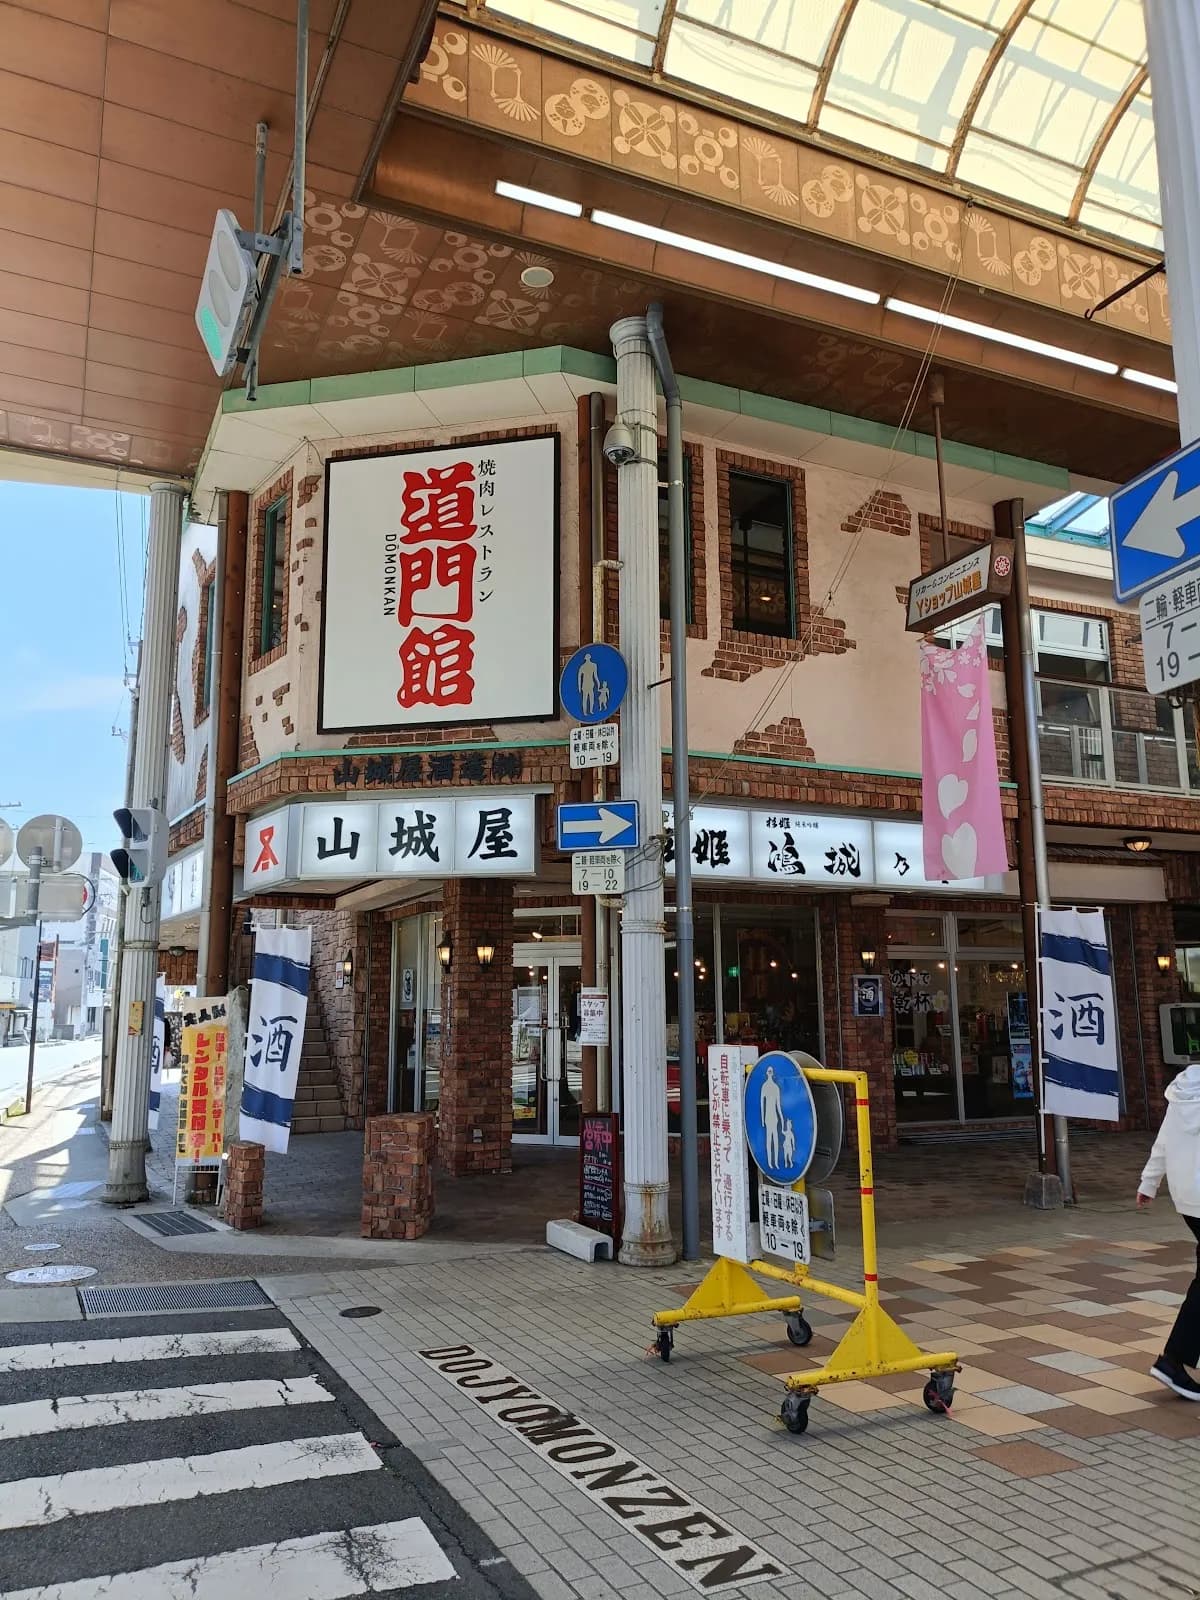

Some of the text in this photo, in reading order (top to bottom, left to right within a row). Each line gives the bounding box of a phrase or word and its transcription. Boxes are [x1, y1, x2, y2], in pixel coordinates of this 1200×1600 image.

[397, 461, 478, 708] 道門館
[478, 459, 496, 602] 焼肉レストラン
[1144, 577, 1200, 624] 二輪・軽車
[317, 807, 519, 863] 山城屋
[250, 1015, 298, 1072] 酒
[1048, 991, 1105, 1046] 酒
[711, 1067, 723, 1239] ことが禁止されています
[720, 1053, 732, 1163] 自転車に乗って
[418, 1344, 783, 1588] DOJYOMONZEN
